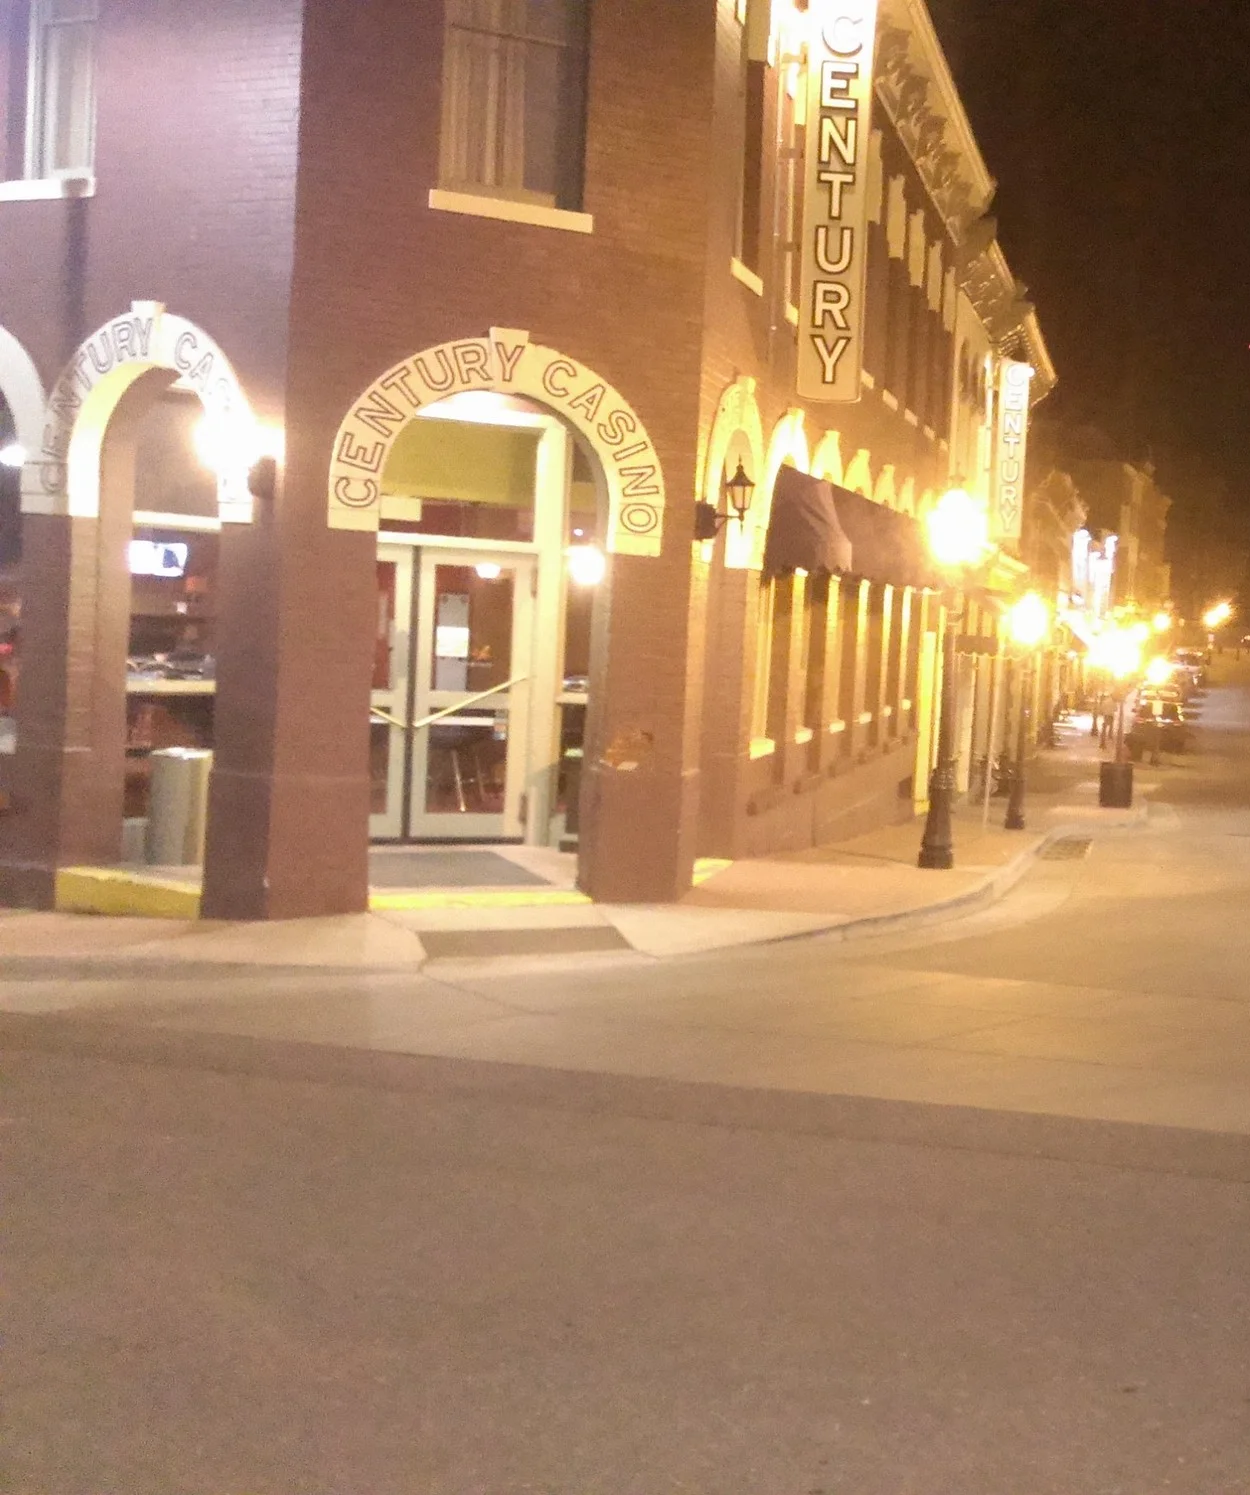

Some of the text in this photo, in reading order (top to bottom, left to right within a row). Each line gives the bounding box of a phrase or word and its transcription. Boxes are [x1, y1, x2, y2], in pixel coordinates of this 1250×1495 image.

[811, 16, 864, 385] CENTURY
[334, 341, 660, 535] CENTURY CASINO
[1000, 364, 1025, 532] CENTURY
